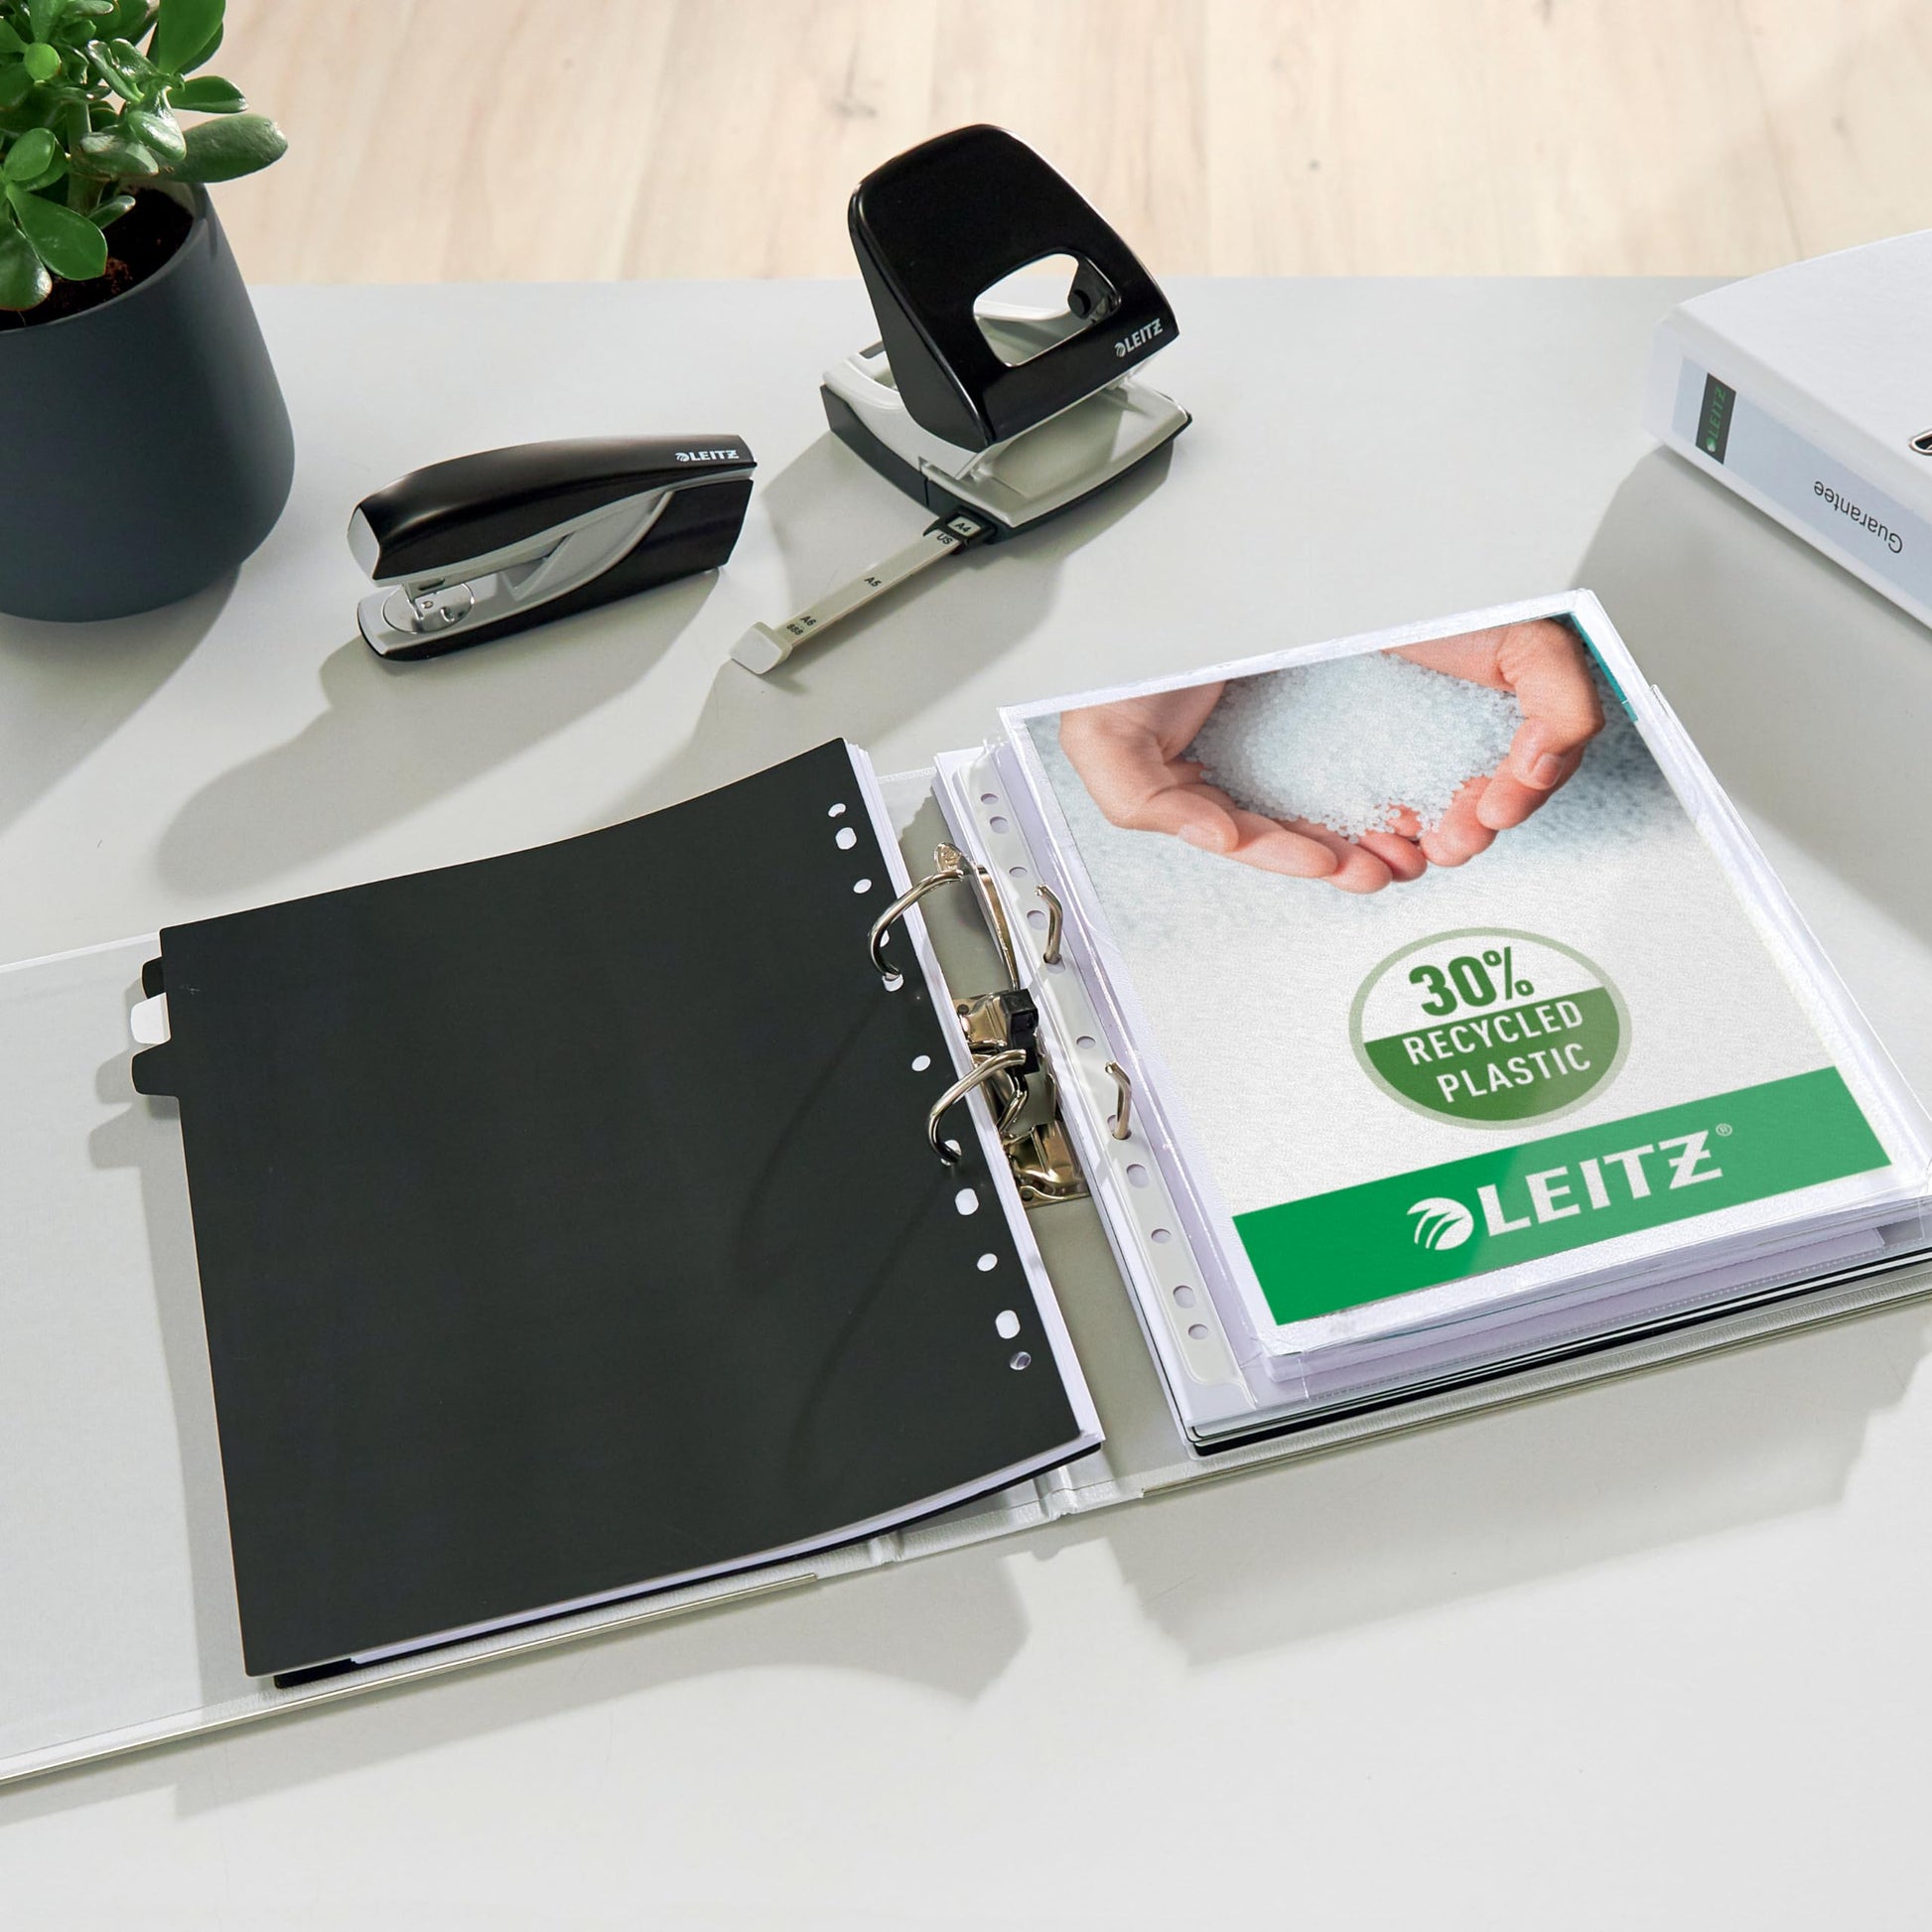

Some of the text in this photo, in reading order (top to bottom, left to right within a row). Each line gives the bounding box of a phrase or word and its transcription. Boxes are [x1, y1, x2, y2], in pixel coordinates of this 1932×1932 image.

[1124, 318, 1164, 352] LEITZ
[688, 449, 740, 462] LEITZ
[954, 522, 972, 533] A4
[1813, 481, 1903, 554] Guarantee
[936, 533, 953, 545] US
[864, 576, 883, 588] A5
[799, 616, 817, 626] A6
[1408, 945, 1535, 1017] 30%
[1401, 999, 1585, 1066] RECYCLED
[1436, 1042, 1591, 1104] PLASTIC
